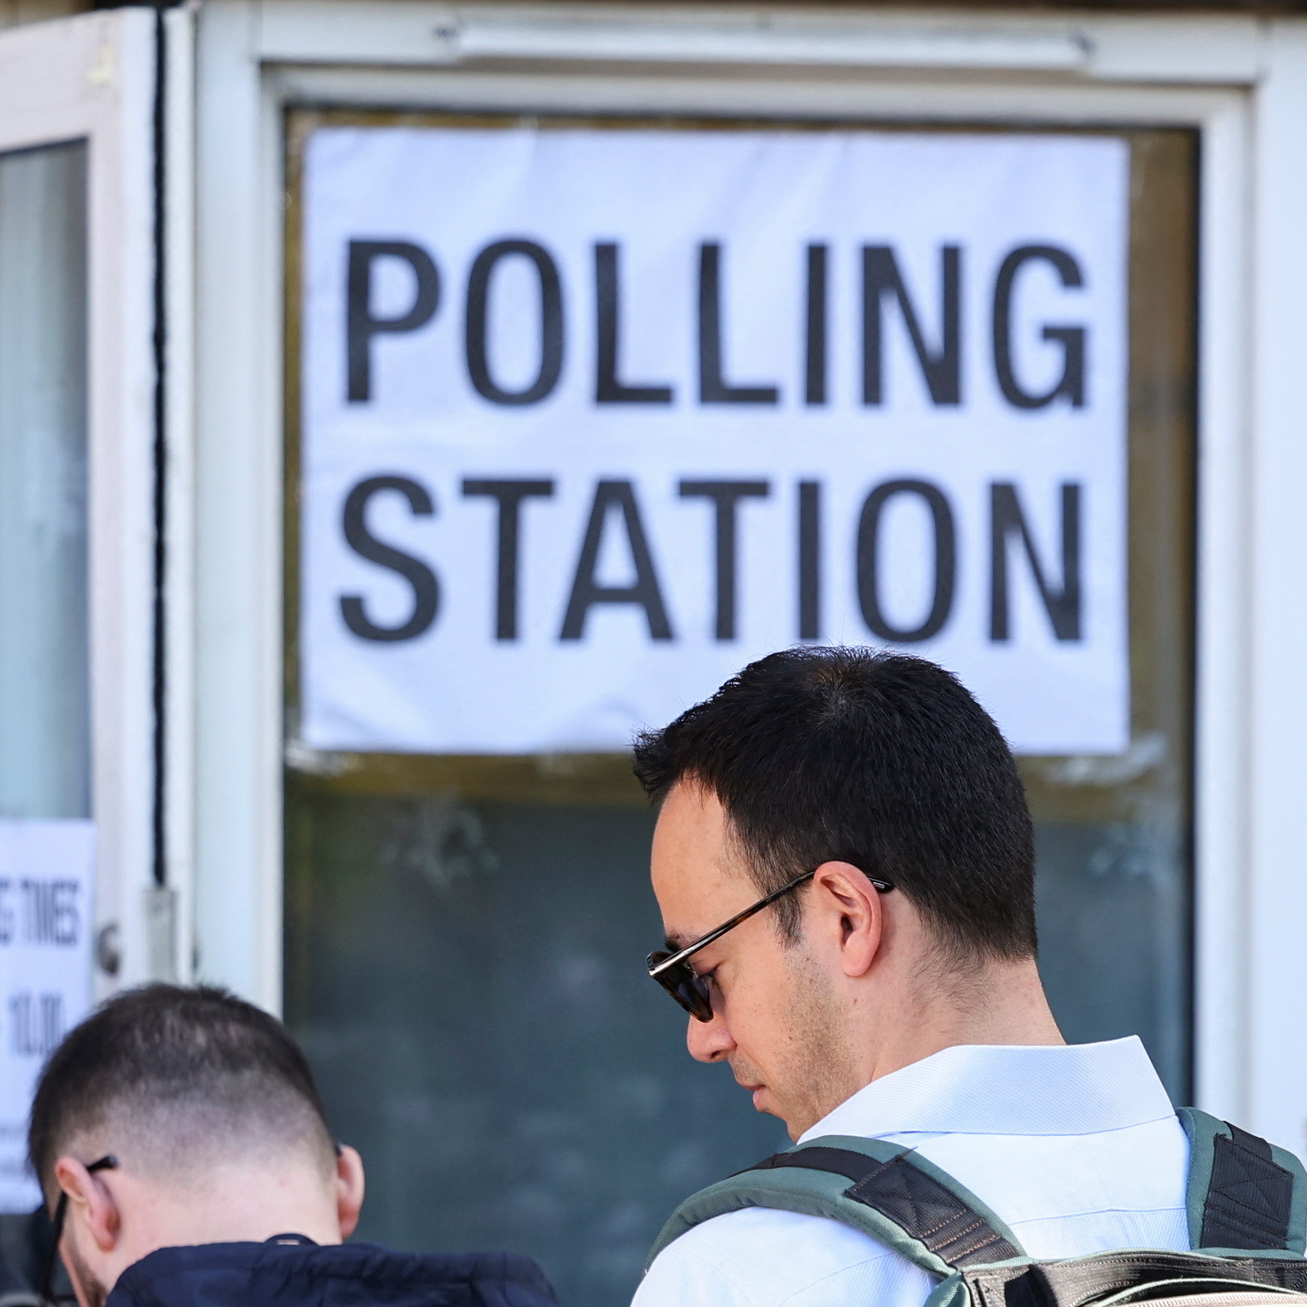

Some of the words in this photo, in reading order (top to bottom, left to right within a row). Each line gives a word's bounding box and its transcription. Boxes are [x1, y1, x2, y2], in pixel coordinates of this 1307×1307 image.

[346, 237, 1086, 411] POLLING
[339, 474, 1083, 644] STATION
[19, 876, 80, 947] TIMES
